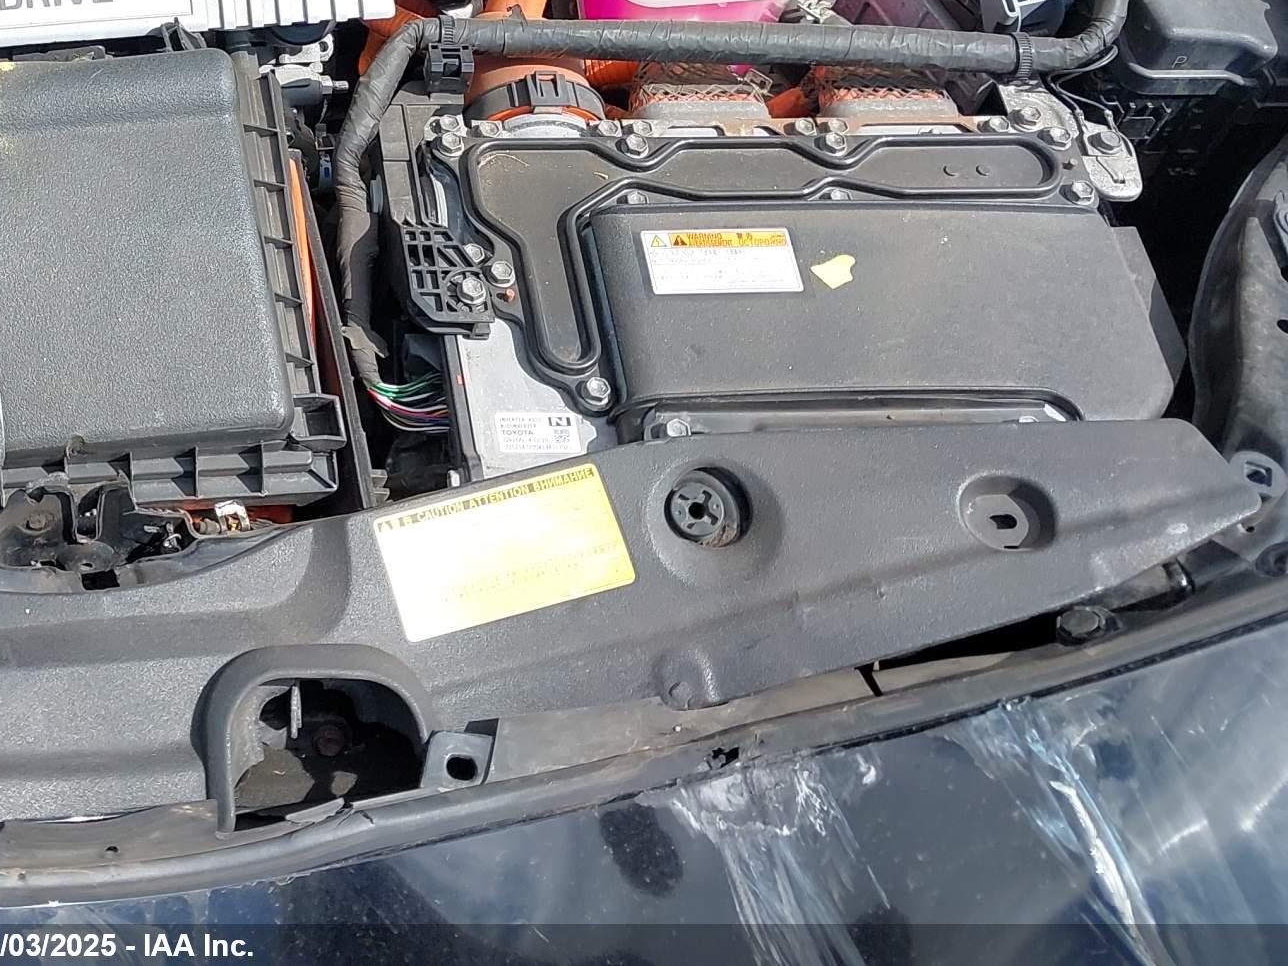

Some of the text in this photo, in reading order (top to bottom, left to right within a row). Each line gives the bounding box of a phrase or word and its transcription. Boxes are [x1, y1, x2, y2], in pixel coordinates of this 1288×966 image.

[534, 469, 594, 492] ВНИМАНИЕ
[417, 501, 463, 522] CAUTION
[469, 485, 530, 510] ATTENTION
